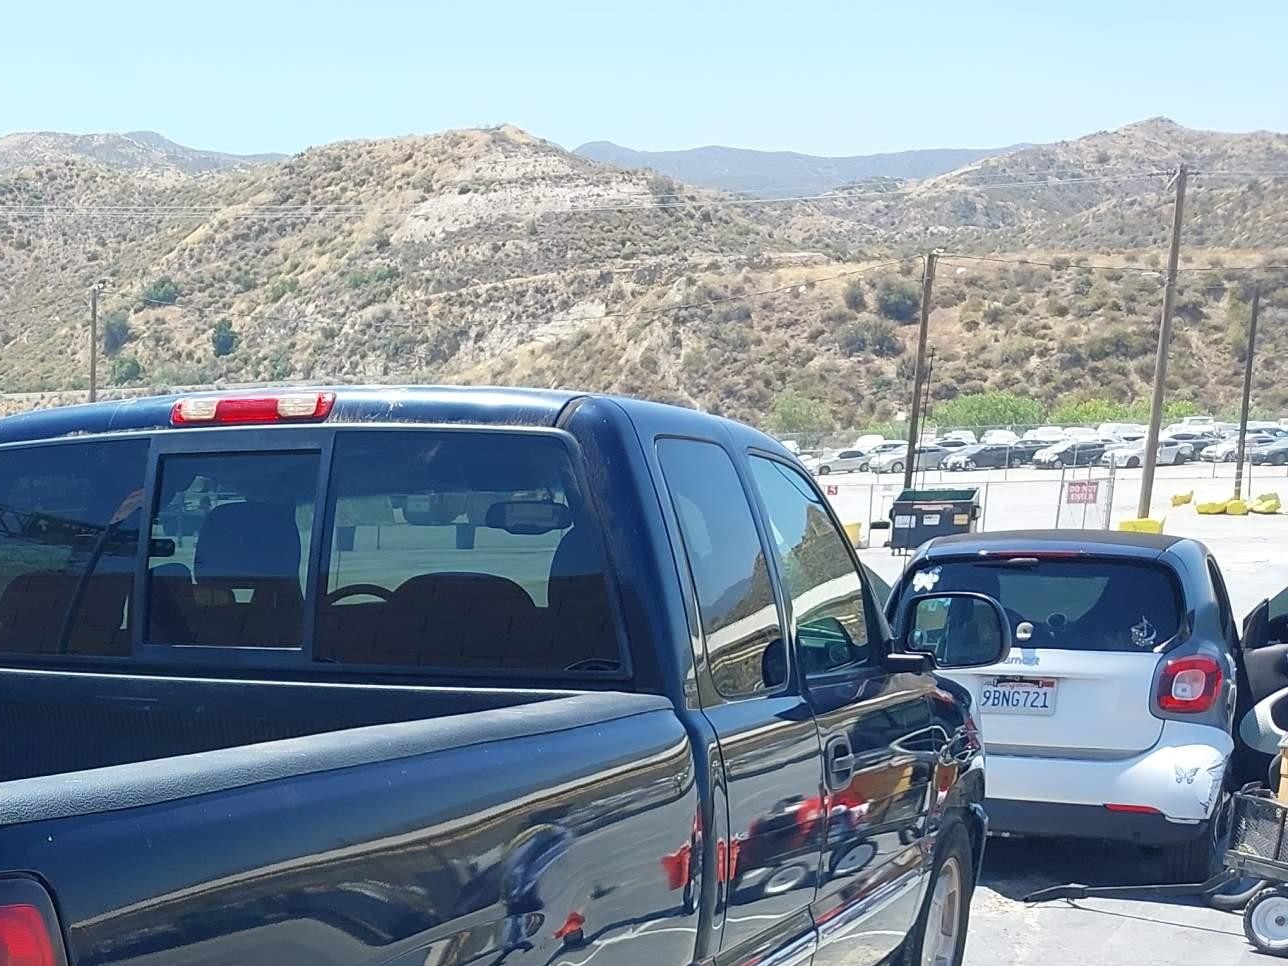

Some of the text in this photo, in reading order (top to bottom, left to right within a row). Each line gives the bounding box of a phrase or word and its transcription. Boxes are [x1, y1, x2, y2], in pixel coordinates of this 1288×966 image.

[1069, 485, 1097, 493] DO NOT
[1070, 493, 1094, 501] ENTER
[981, 689, 1049, 708] 9BNG721
